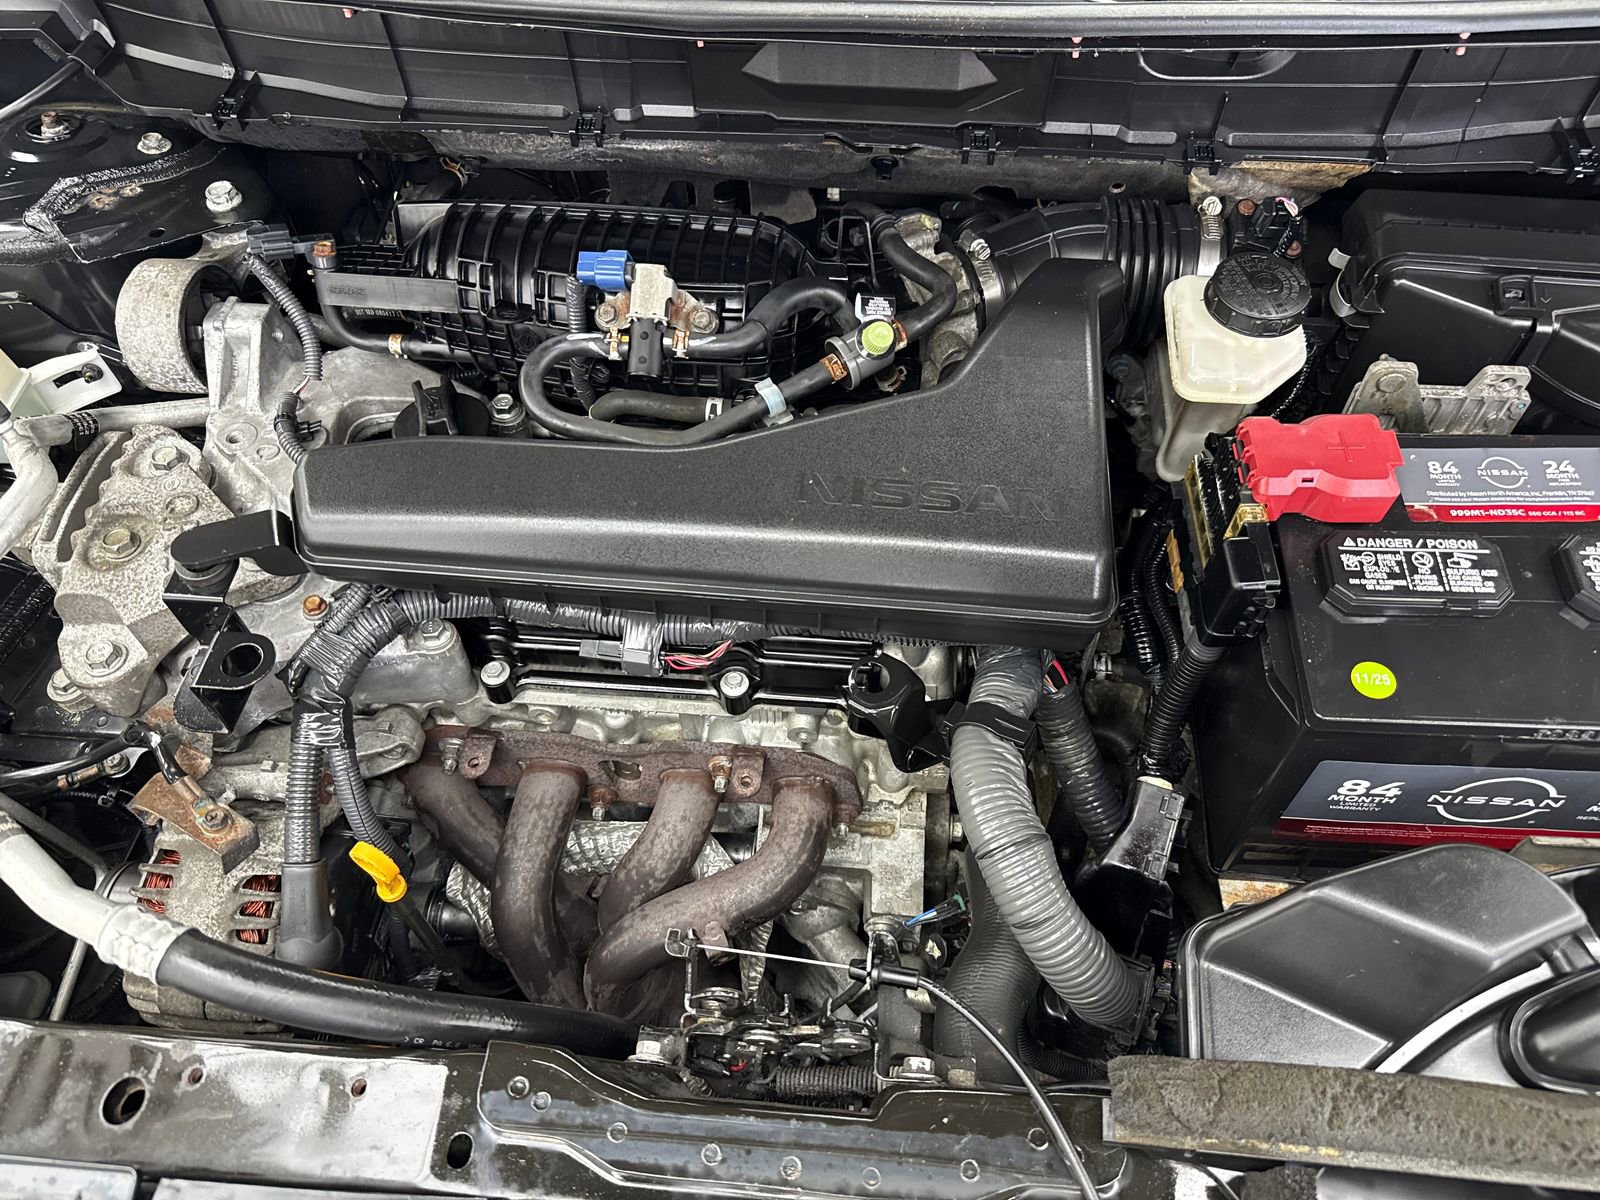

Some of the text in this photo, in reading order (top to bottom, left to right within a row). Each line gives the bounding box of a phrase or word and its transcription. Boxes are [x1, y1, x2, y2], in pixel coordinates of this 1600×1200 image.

[1427, 461, 1459, 474] 84
[1542, 459, 1576, 473] 24
[799, 472, 1064, 521] NISSAN
[1449, 508, 1525, 517] 999M1-ND35C
[1356, 537, 1479, 550] DANGER / POISON
[1376, 553, 1402, 561] SHIELD
[1364, 571, 1388, 579] GASES
[1418, 567, 1431, 575] NO
[1445, 567, 1498, 577] SULFURIC ACID
[1353, 672, 1391, 686] 11/25
[1337, 779, 1405, 797] 84
[1327, 794, 1397, 804] MONTH
[1426, 794, 1566, 808] NISSAN
[1329, 804, 1381, 812] WARRANTY
